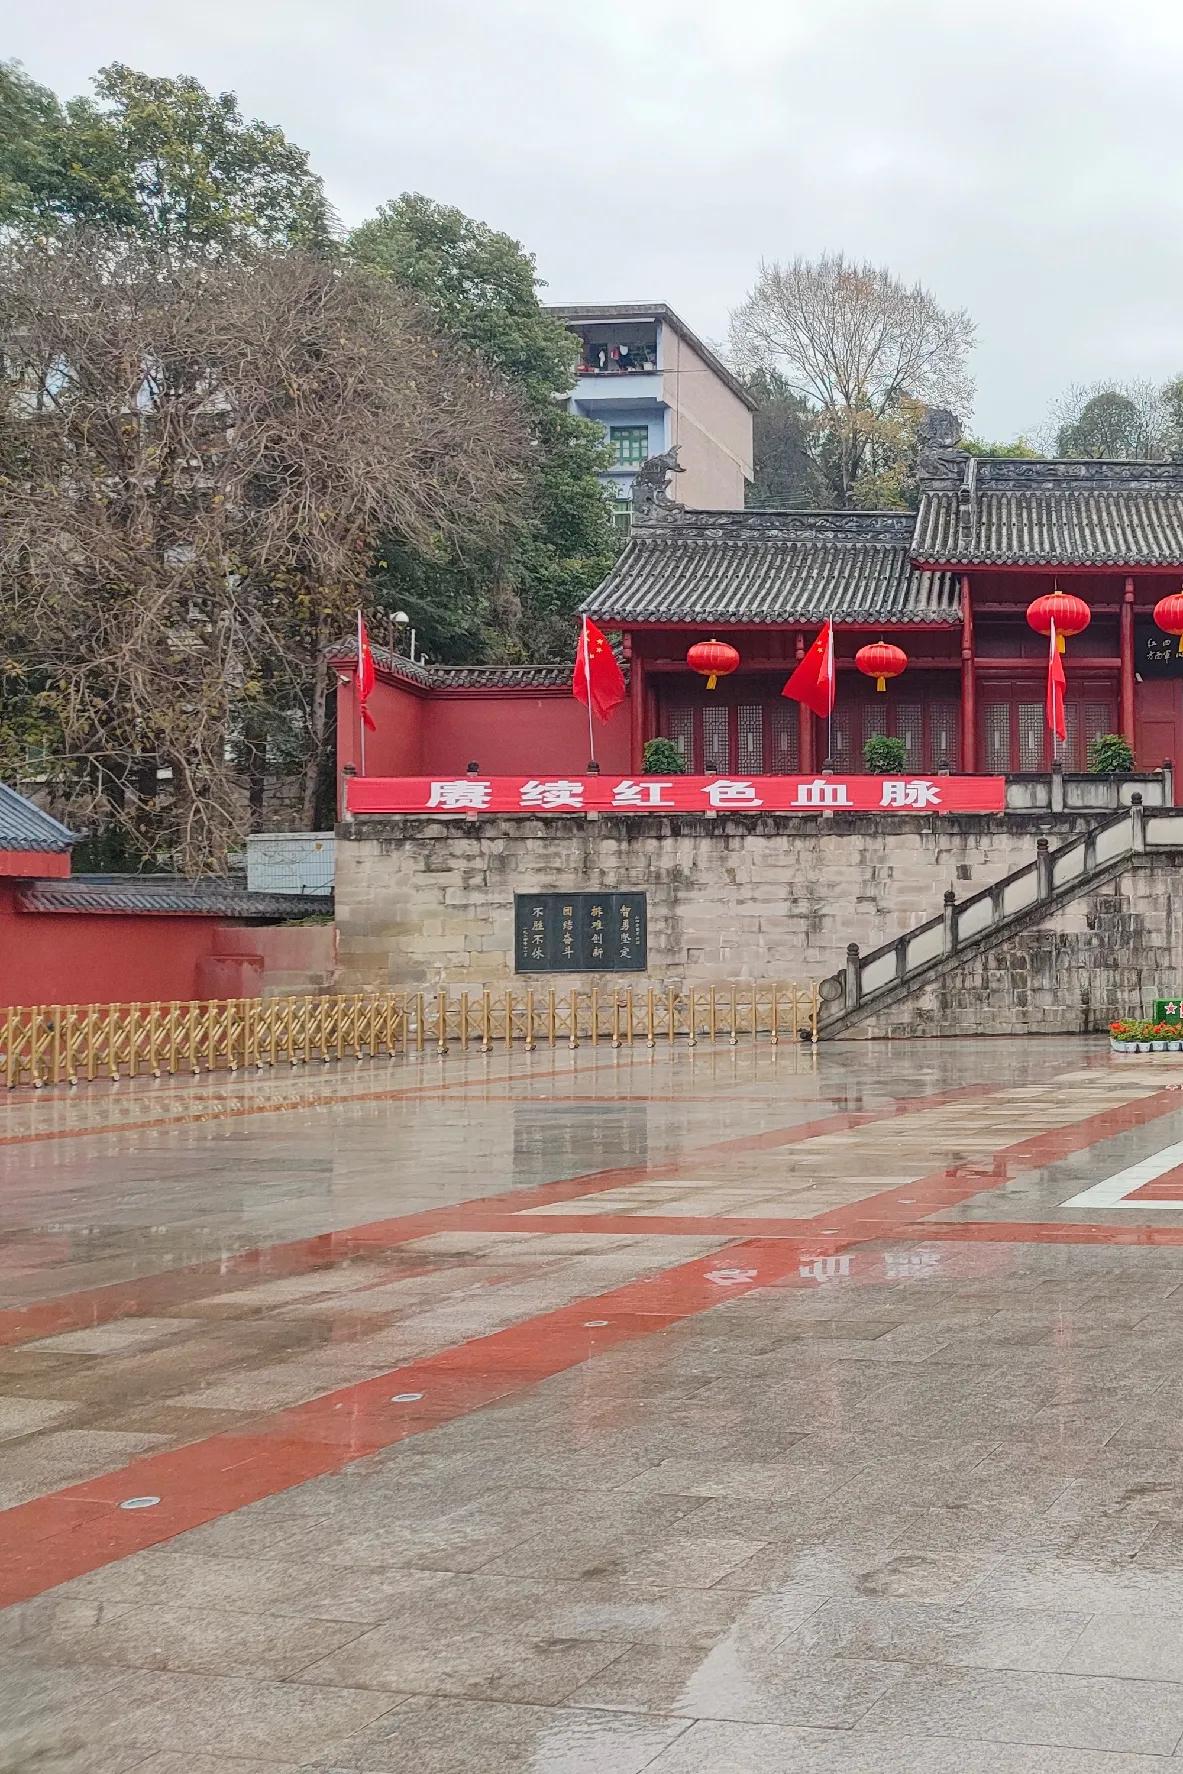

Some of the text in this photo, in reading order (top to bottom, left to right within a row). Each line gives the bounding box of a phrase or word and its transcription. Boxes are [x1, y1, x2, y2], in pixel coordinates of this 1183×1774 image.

[426, 779, 942, 808] 赓续红色血脉
[532, 907, 545, 960] 不胜不休
[562, 906, 574, 959] 团结奋斗
